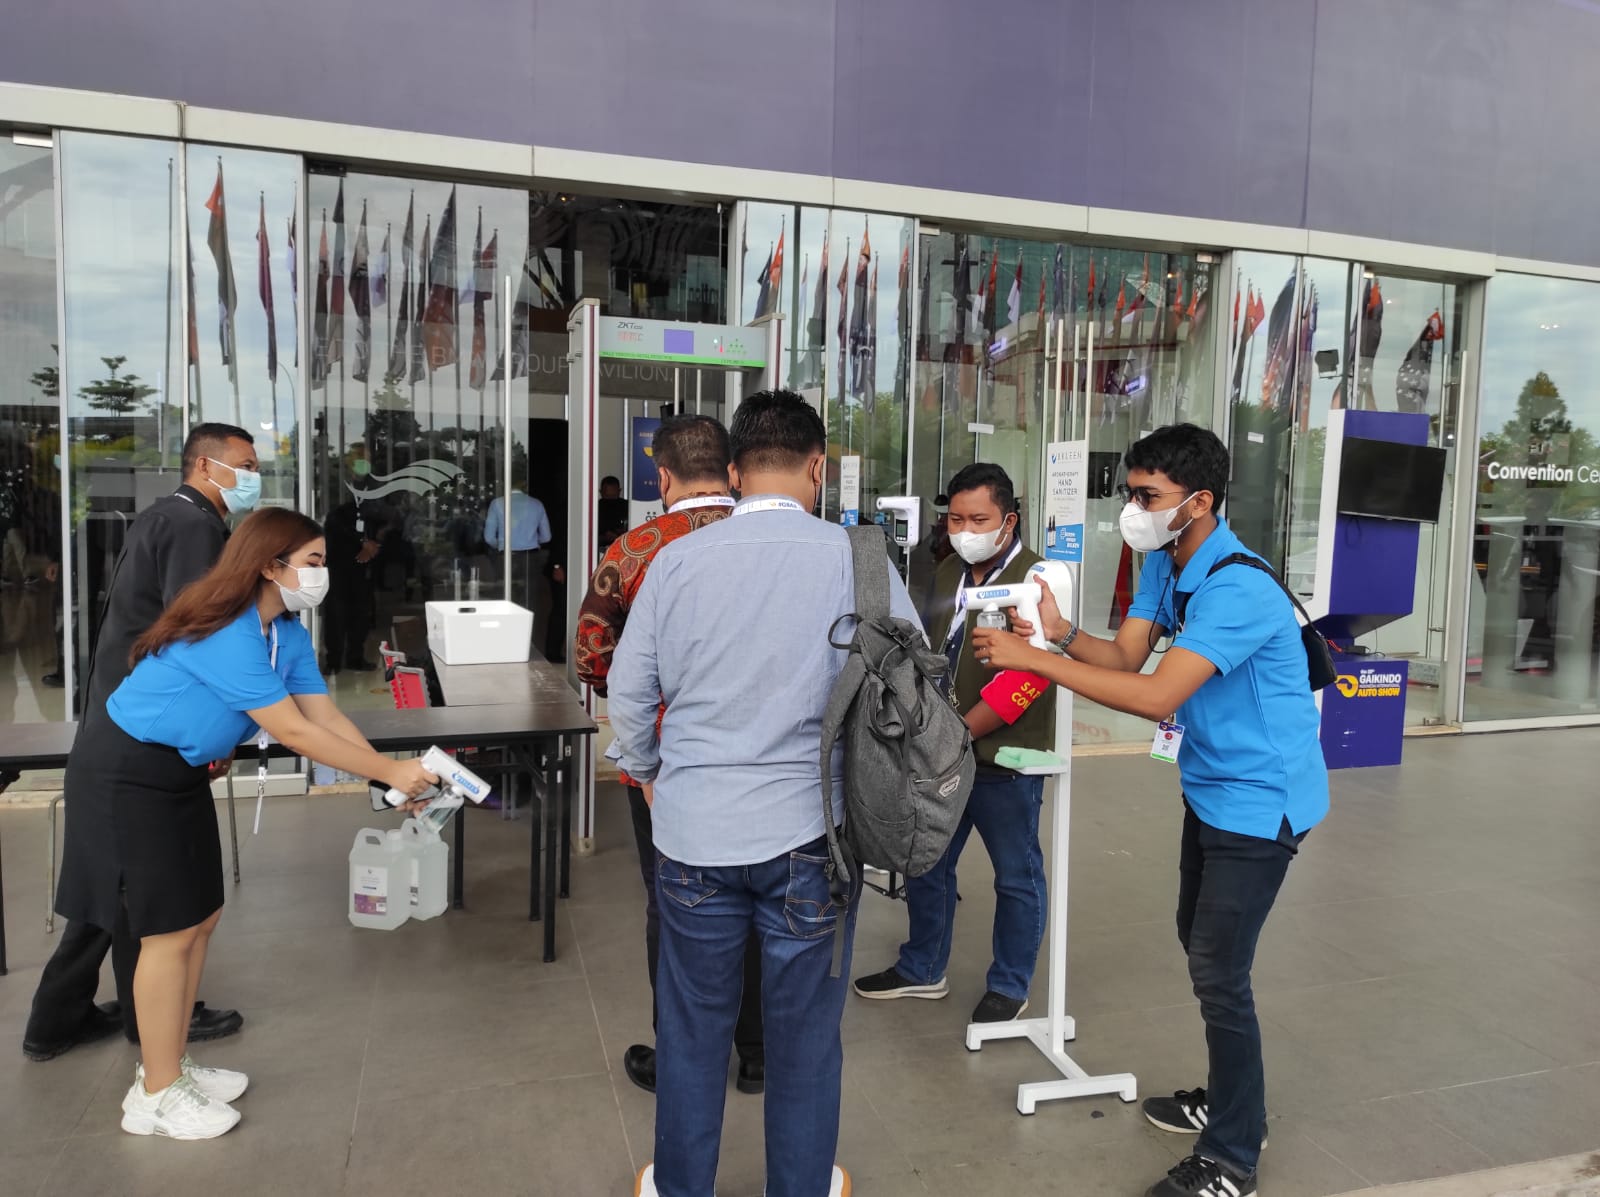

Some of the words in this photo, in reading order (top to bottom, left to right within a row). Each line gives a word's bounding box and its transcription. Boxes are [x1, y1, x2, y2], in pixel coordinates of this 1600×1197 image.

[1487, 461, 1574, 482] Convention
[1052, 487, 1078, 496] SANITIZER
[1359, 673, 1402, 684] GAIKINDO
[1357, 688, 1377, 697] AUTO
[1377, 687, 1401, 697] SHOW
